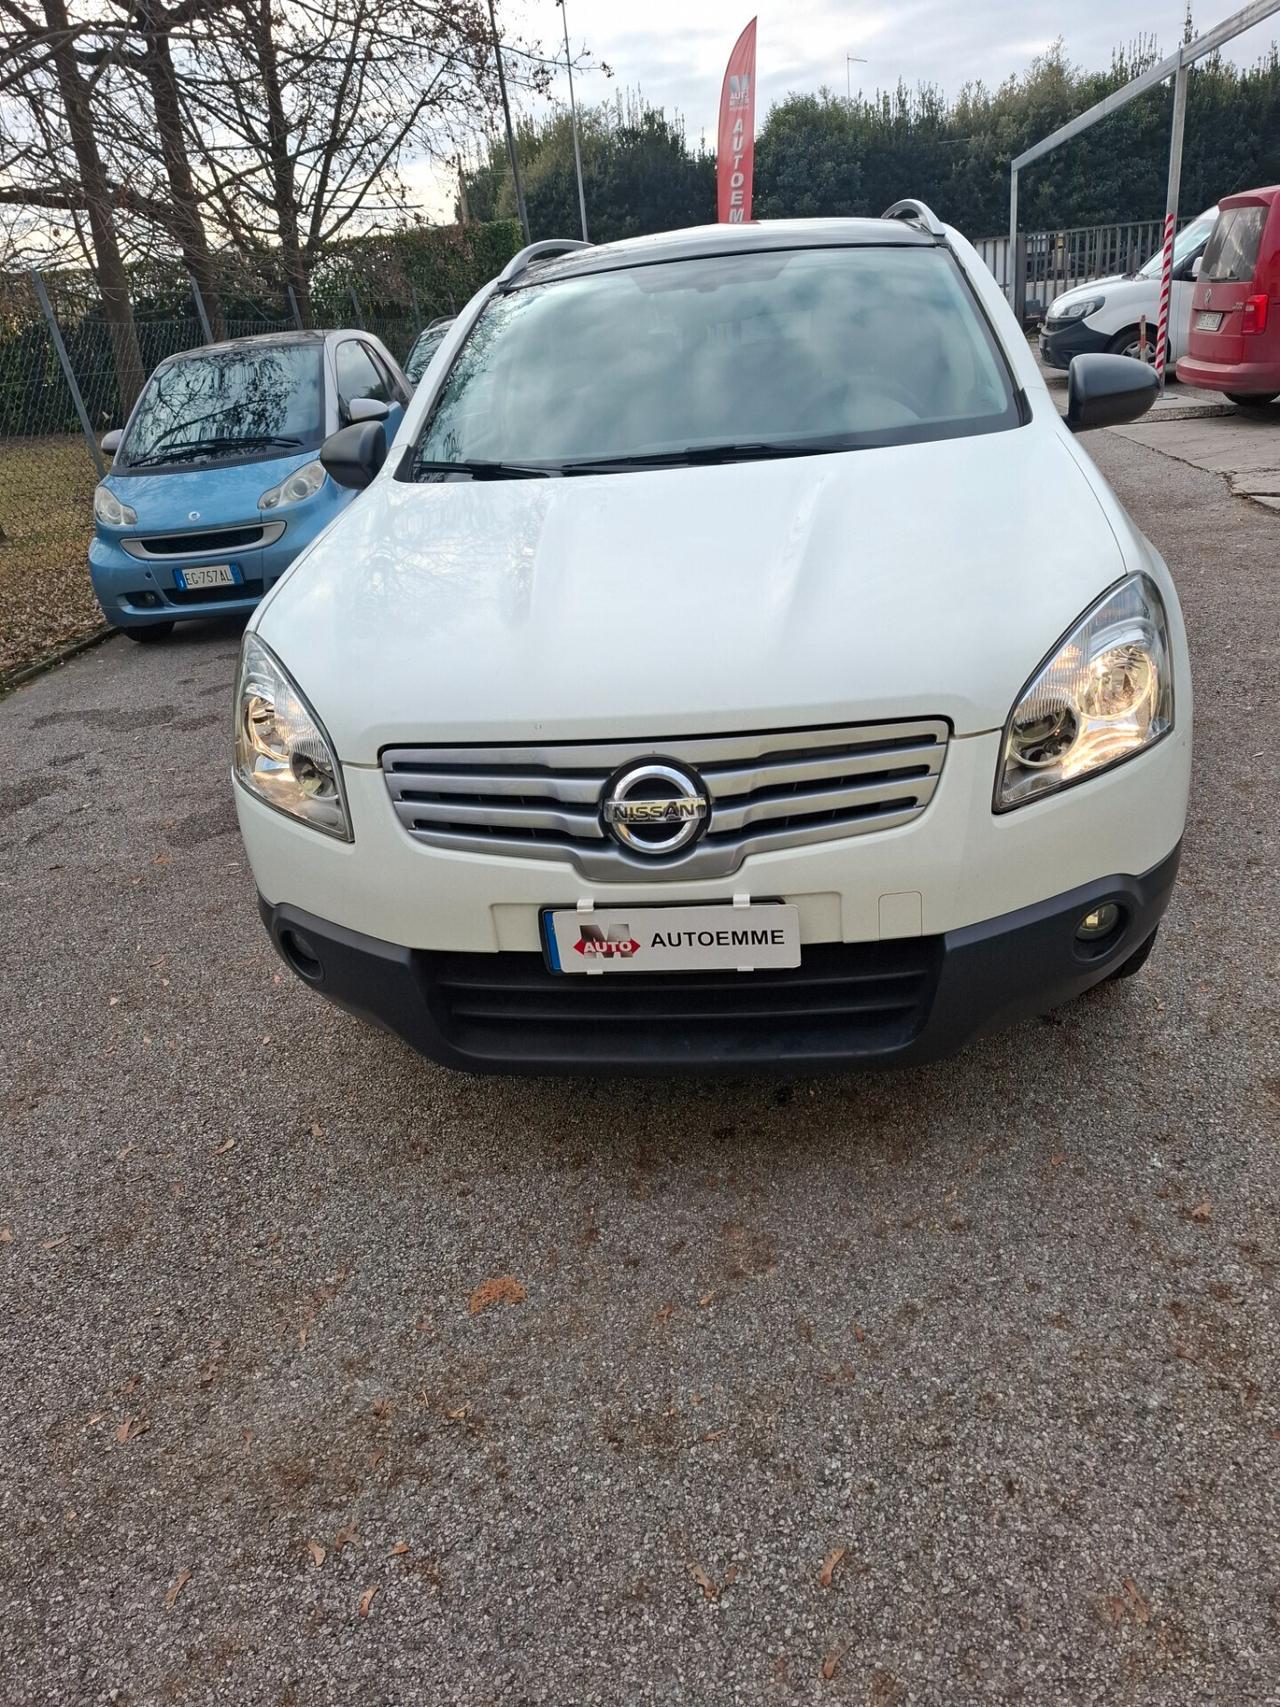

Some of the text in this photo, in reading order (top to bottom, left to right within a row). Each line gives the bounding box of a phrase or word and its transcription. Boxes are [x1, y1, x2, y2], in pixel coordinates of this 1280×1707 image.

[614, 801, 695, 820] NISSAN
[583, 939, 632, 953] AUTO
[651, 930, 785, 947] AUTOEMME
